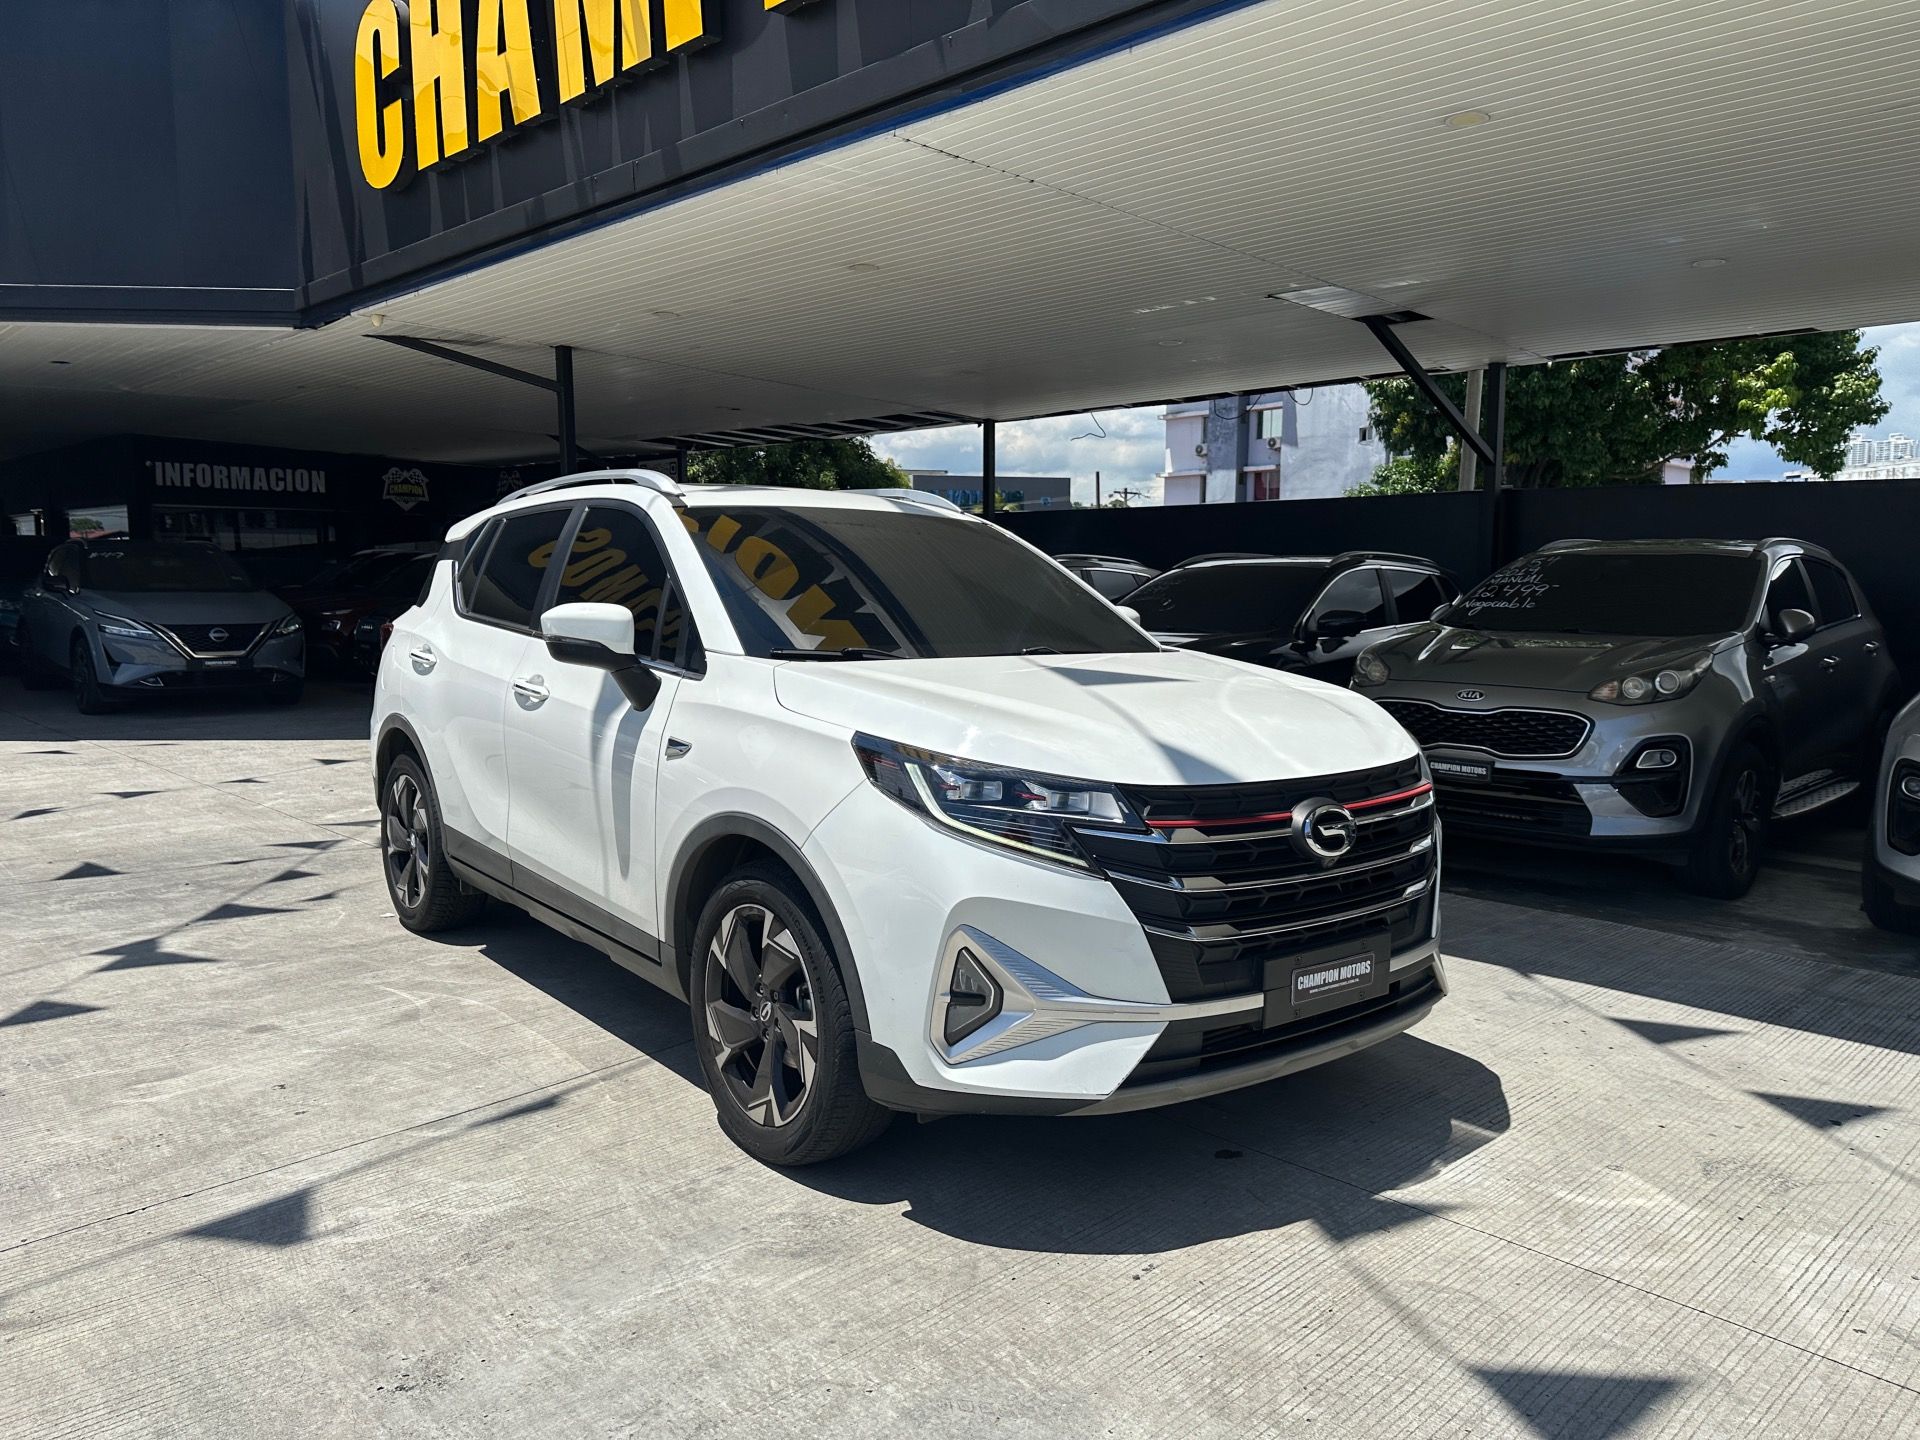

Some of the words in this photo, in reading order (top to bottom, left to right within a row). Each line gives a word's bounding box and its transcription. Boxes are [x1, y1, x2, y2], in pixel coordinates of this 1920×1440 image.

[154, 460, 327, 495] INFORMACION
[1487, 574, 1544, 584] MANUAL
[1430, 761, 1461, 772] CHAMPION
[1461, 765, 1487, 775] MOTORS
[1297, 967, 1340, 990] CHAMPION
[1339, 960, 1371, 980] MOTORS
